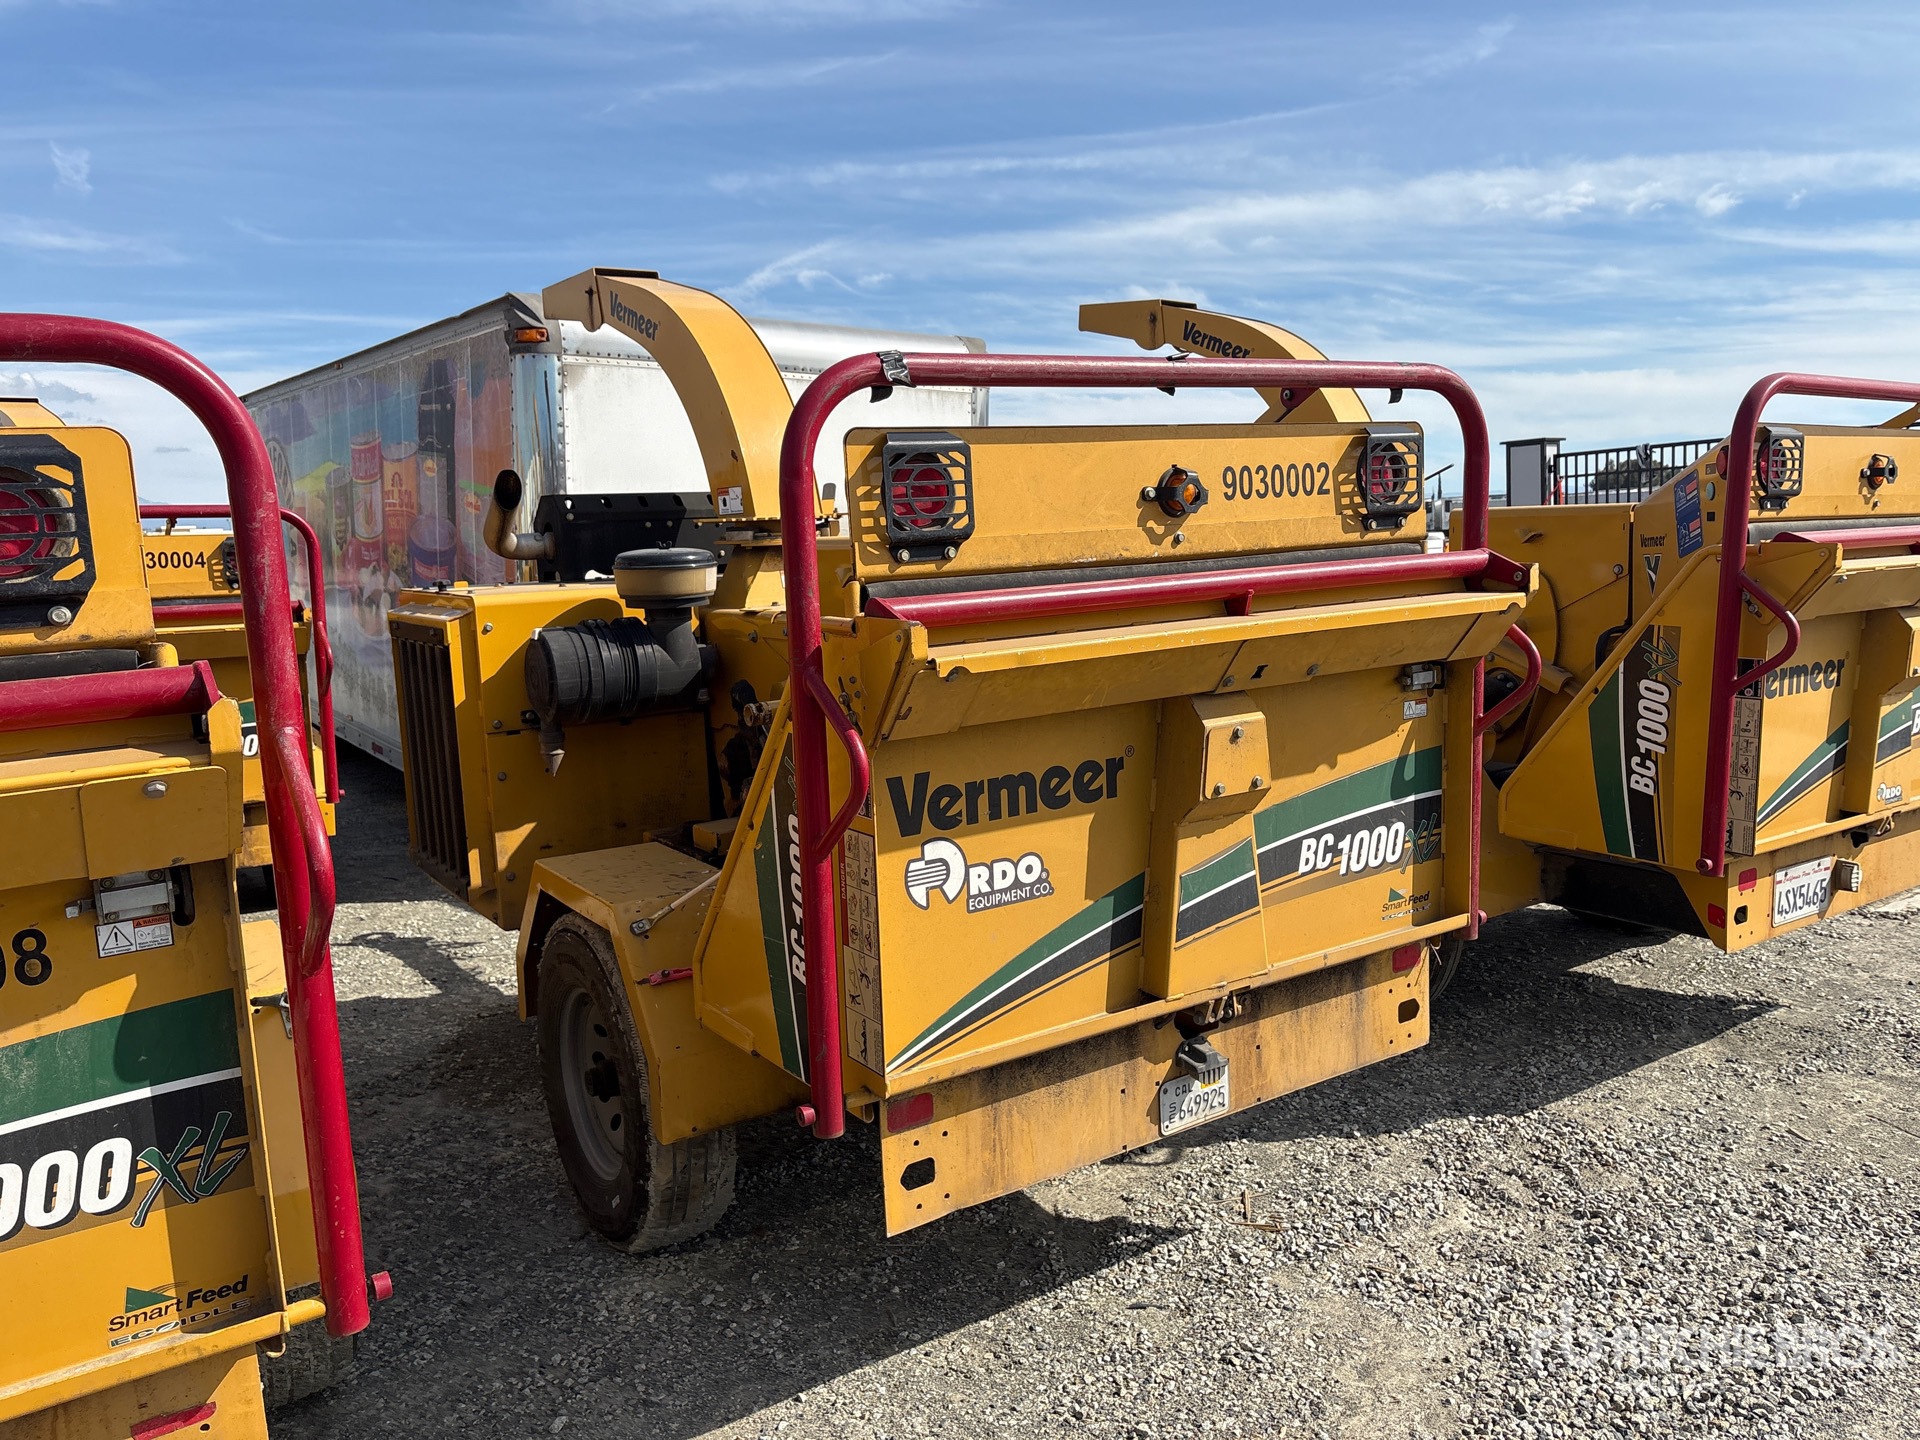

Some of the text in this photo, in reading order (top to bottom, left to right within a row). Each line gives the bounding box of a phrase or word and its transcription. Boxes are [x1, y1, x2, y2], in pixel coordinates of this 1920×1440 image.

[609, 290, 659, 342] Vermeer
[1182, 319, 1251, 359] Vermeer
[1222, 461, 1331, 501] 9030002
[145, 551, 207, 569] 30004
[1640, 533, 1666, 548] Vermeer
[1764, 658, 1846, 700] ermeer
[885, 755, 1126, 838] Vermeer
[968, 885, 1032, 912] EQUIPMENT
[1777, 878, 1827, 917] 4SX5465
[0, 928, 53, 990] 8
[1174, 1083, 1194, 1097] CAL
[1178, 1085, 1226, 1121] 649925
